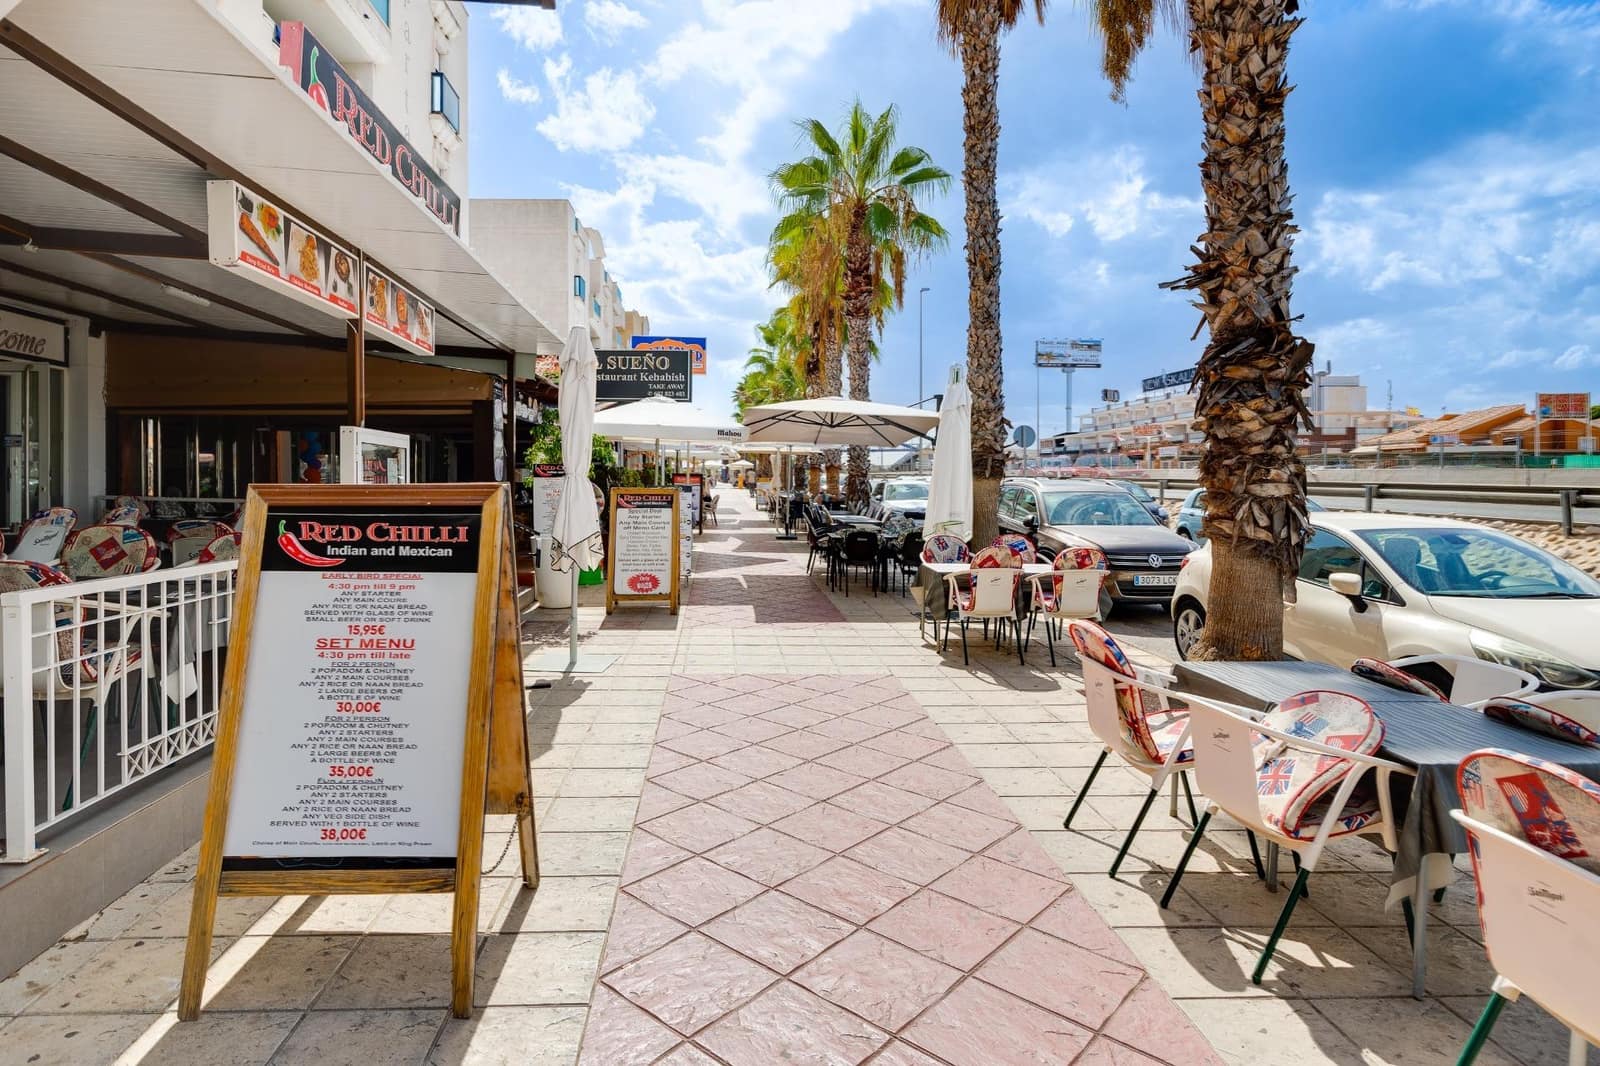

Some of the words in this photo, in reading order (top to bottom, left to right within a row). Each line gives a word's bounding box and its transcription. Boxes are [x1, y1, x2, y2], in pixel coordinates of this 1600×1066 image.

[333, 71, 392, 165] RED
[395, 144, 460, 236] CHILLI
[606, 353, 670, 370] SUEÑO
[298, 521, 362, 543] RED
[366, 522, 469, 543] CHILLI
[327, 545, 367, 556] Indian
[370, 545, 395, 556] and
[399, 546, 453, 557] Mexican
[1140, 576, 1161, 584] 3073
[347, 625, 386, 636] 15,95€
[316, 638, 354, 649] SET
[359, 638, 416, 650] MENU
[336, 702, 382, 713] 30,00€
[328, 766, 374, 778] 35,00€
[320, 828, 368, 841] 38,00€
